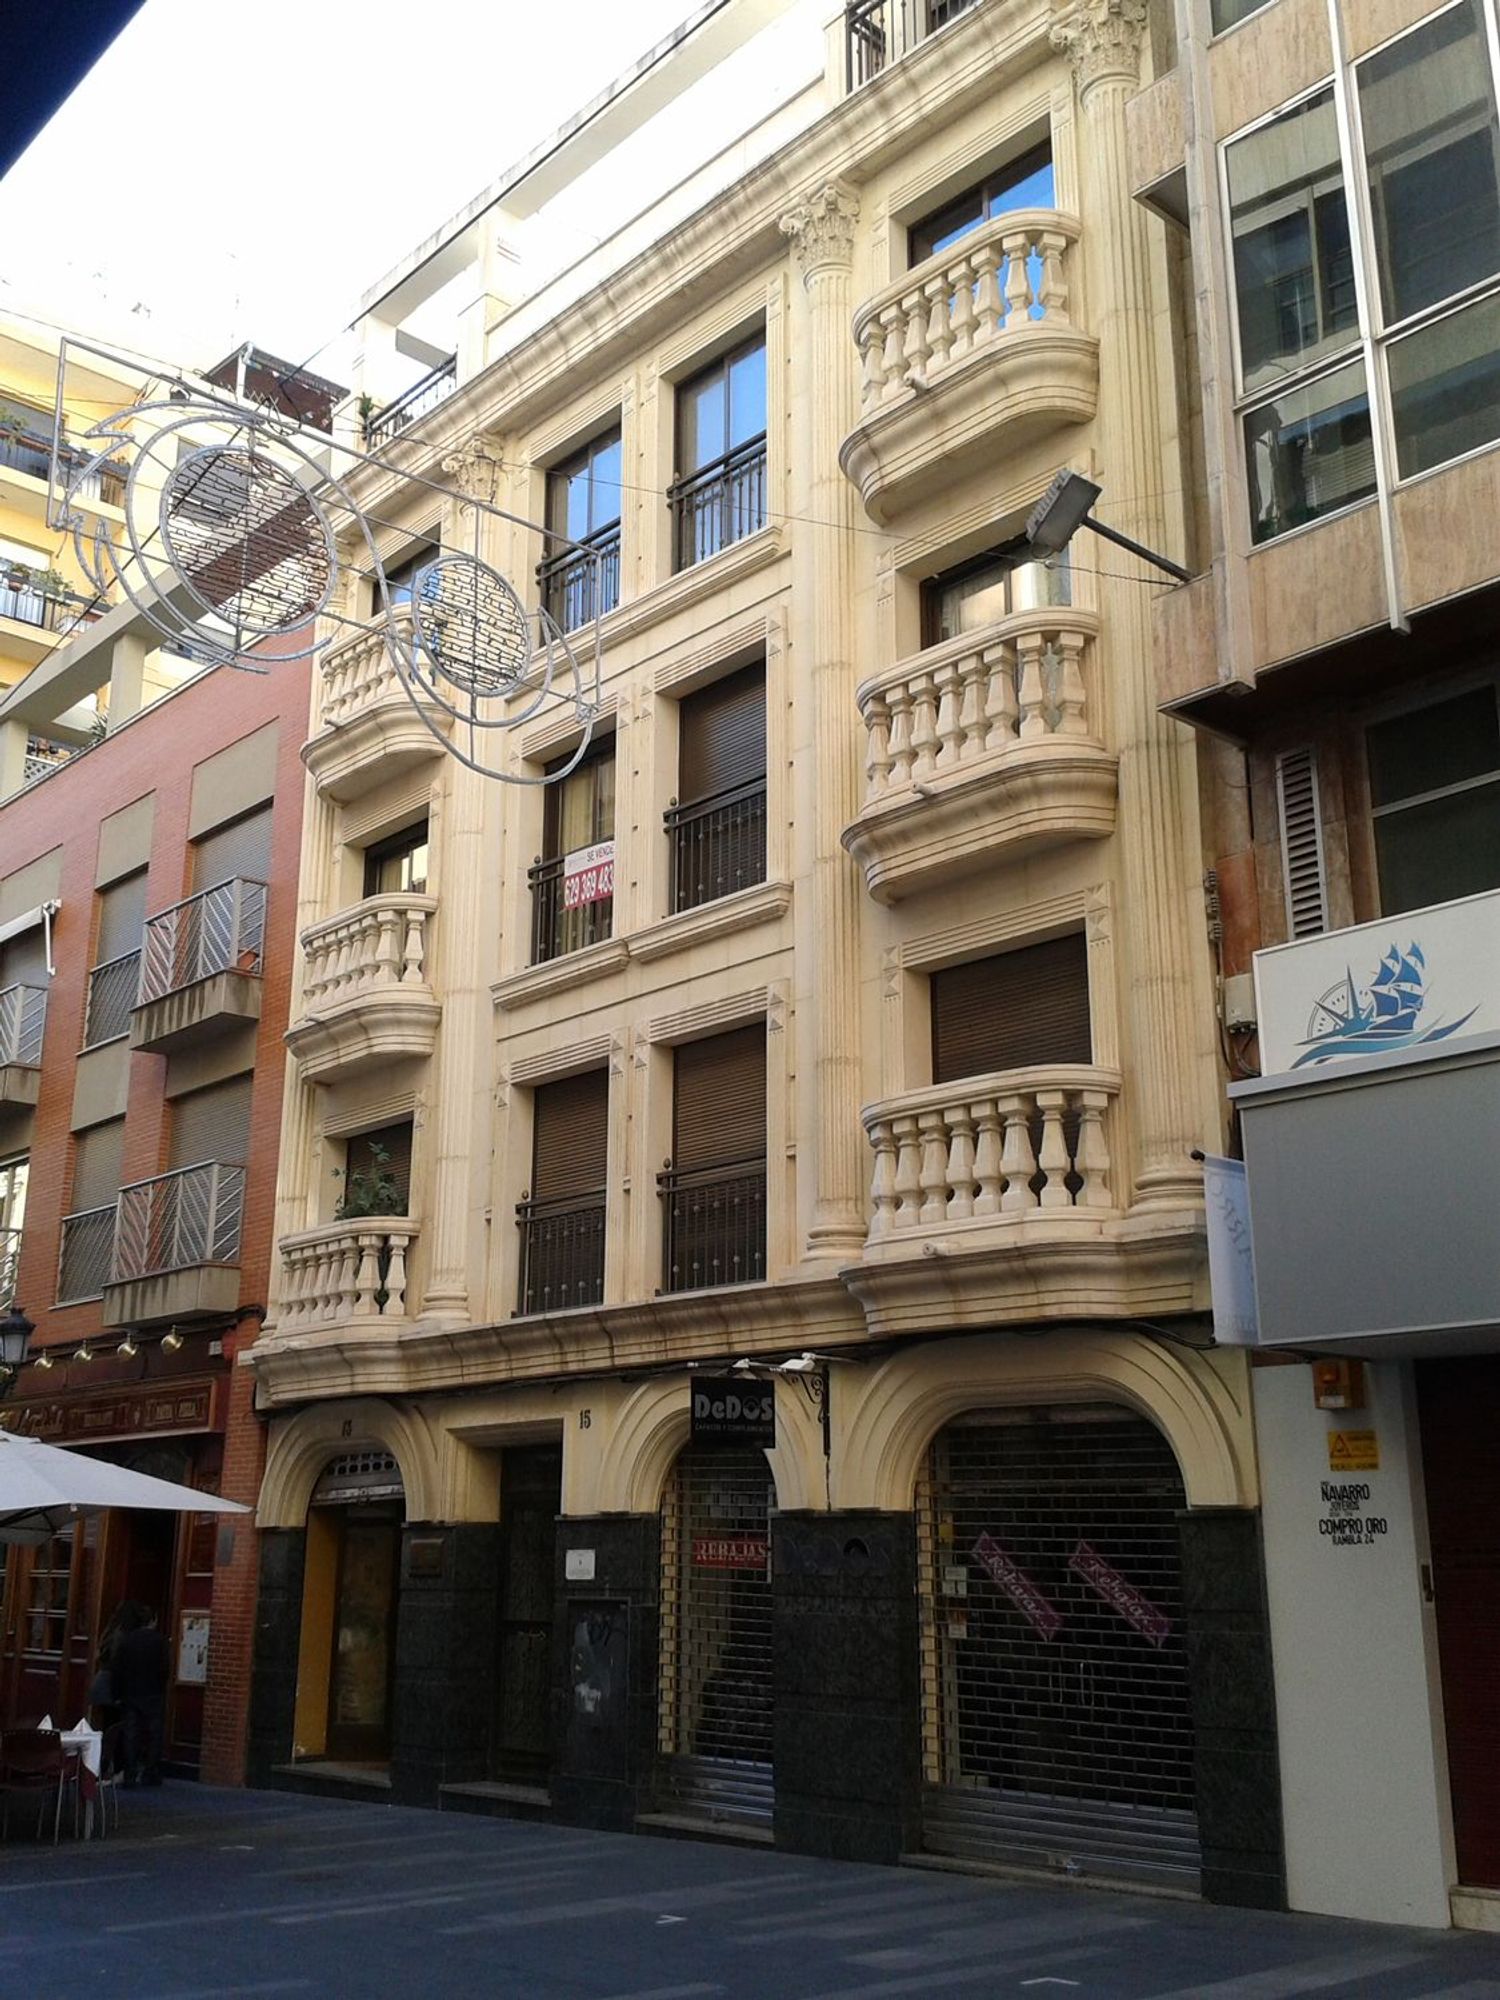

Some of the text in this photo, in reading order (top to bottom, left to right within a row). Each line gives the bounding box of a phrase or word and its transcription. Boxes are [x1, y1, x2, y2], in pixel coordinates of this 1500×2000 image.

[587, 850, 595, 862] SE
[565, 877, 580, 907] 629
[581, 870, 597, 900] 369
[579, 1409, 591, 1430] 15
[1321, 1484, 1370, 1501] NAVARRO
[1319, 1517, 1388, 1535] COMPRO ORO
[1332, 1533, 1374, 1546] RAMBLA 24
[695, 1541, 767, 1561] REBAJAS
